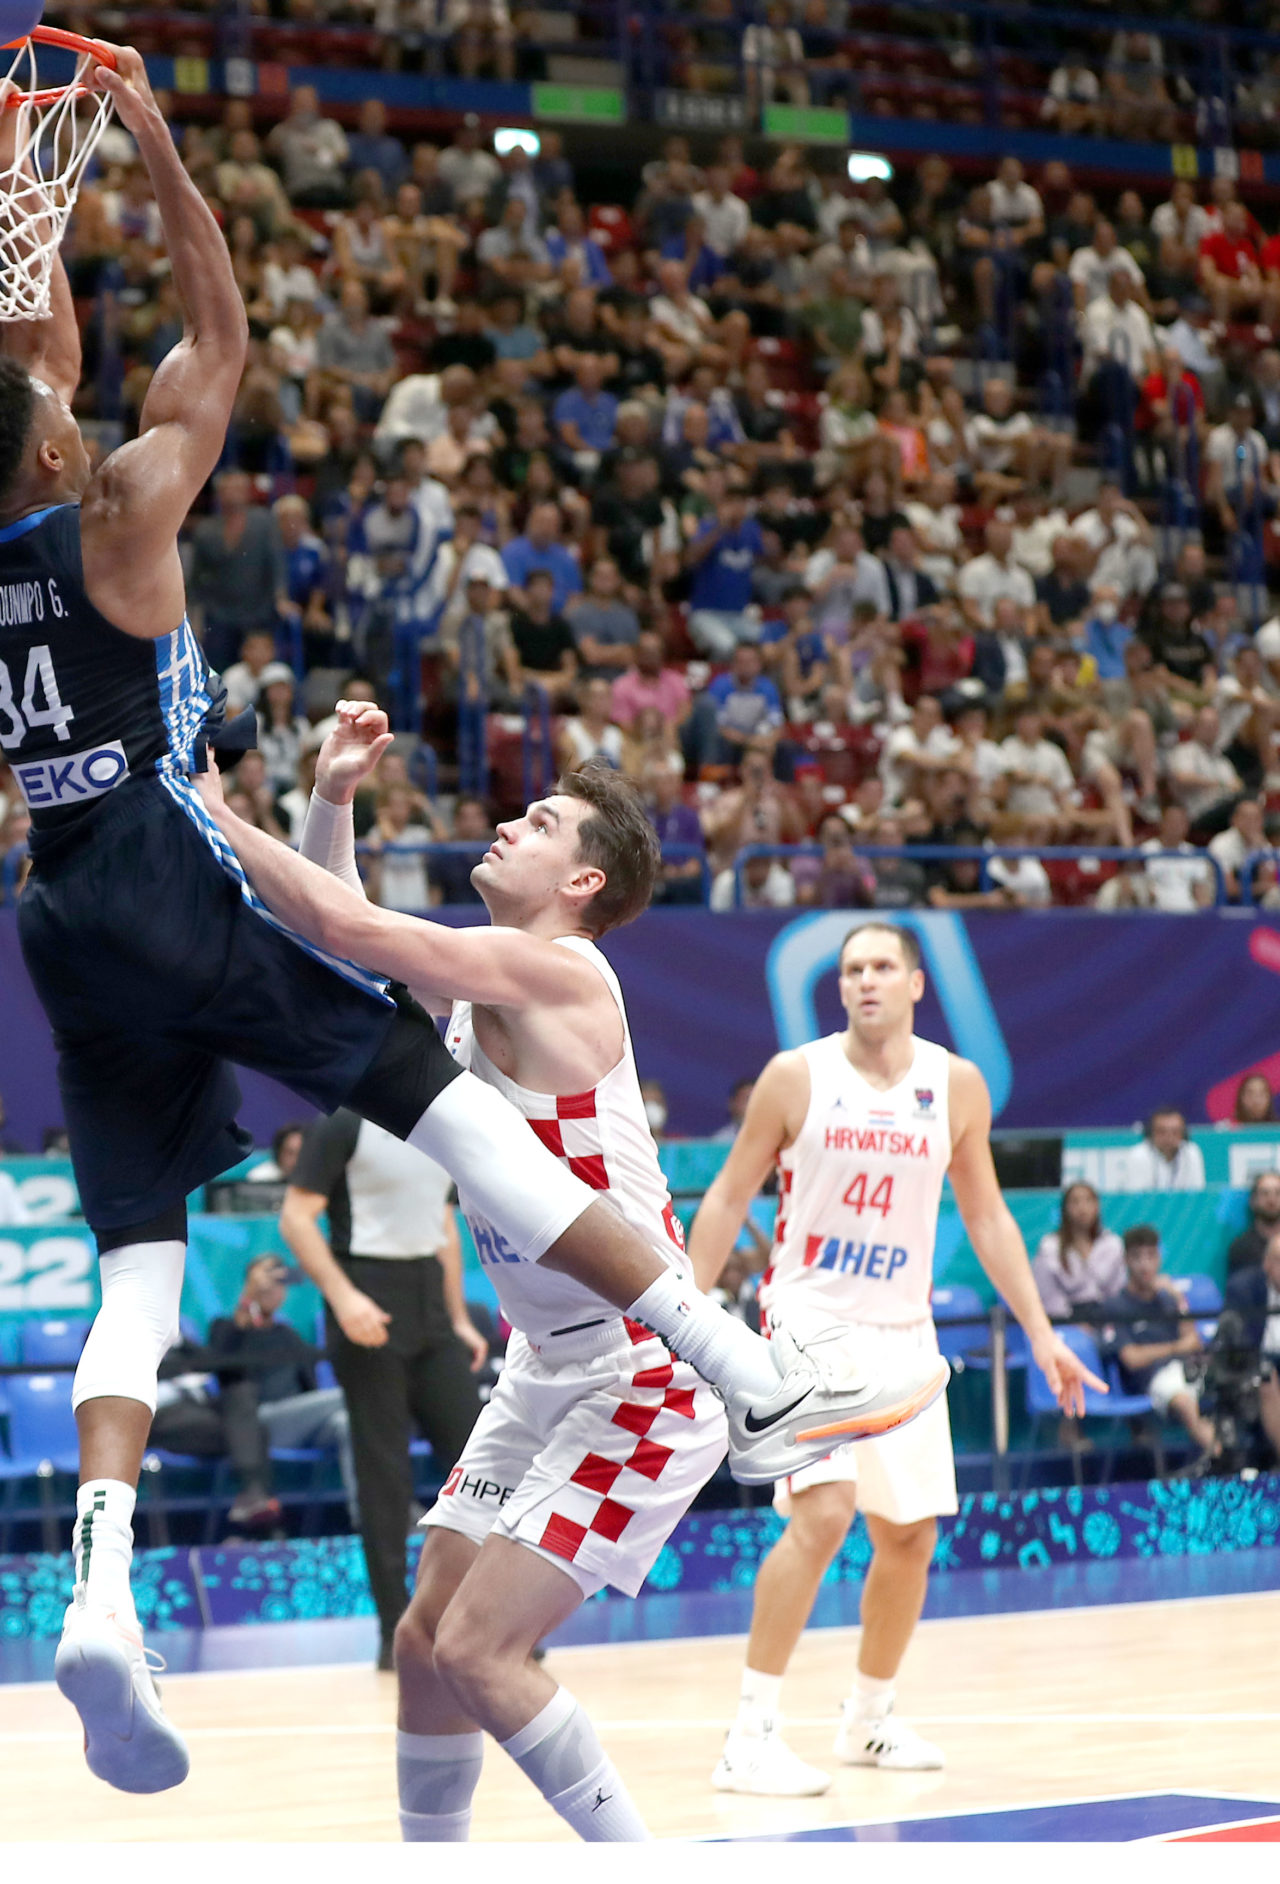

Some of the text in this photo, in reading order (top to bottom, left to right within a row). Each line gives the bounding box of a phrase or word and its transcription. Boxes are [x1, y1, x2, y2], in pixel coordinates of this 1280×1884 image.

[48, 577, 69, 619] G.
[18, 749, 126, 803] EKO
[824, 1126, 930, 1159] HRVATSKA
[842, 1171, 895, 1220] 44
[839, 1240, 908, 1281] HEP
